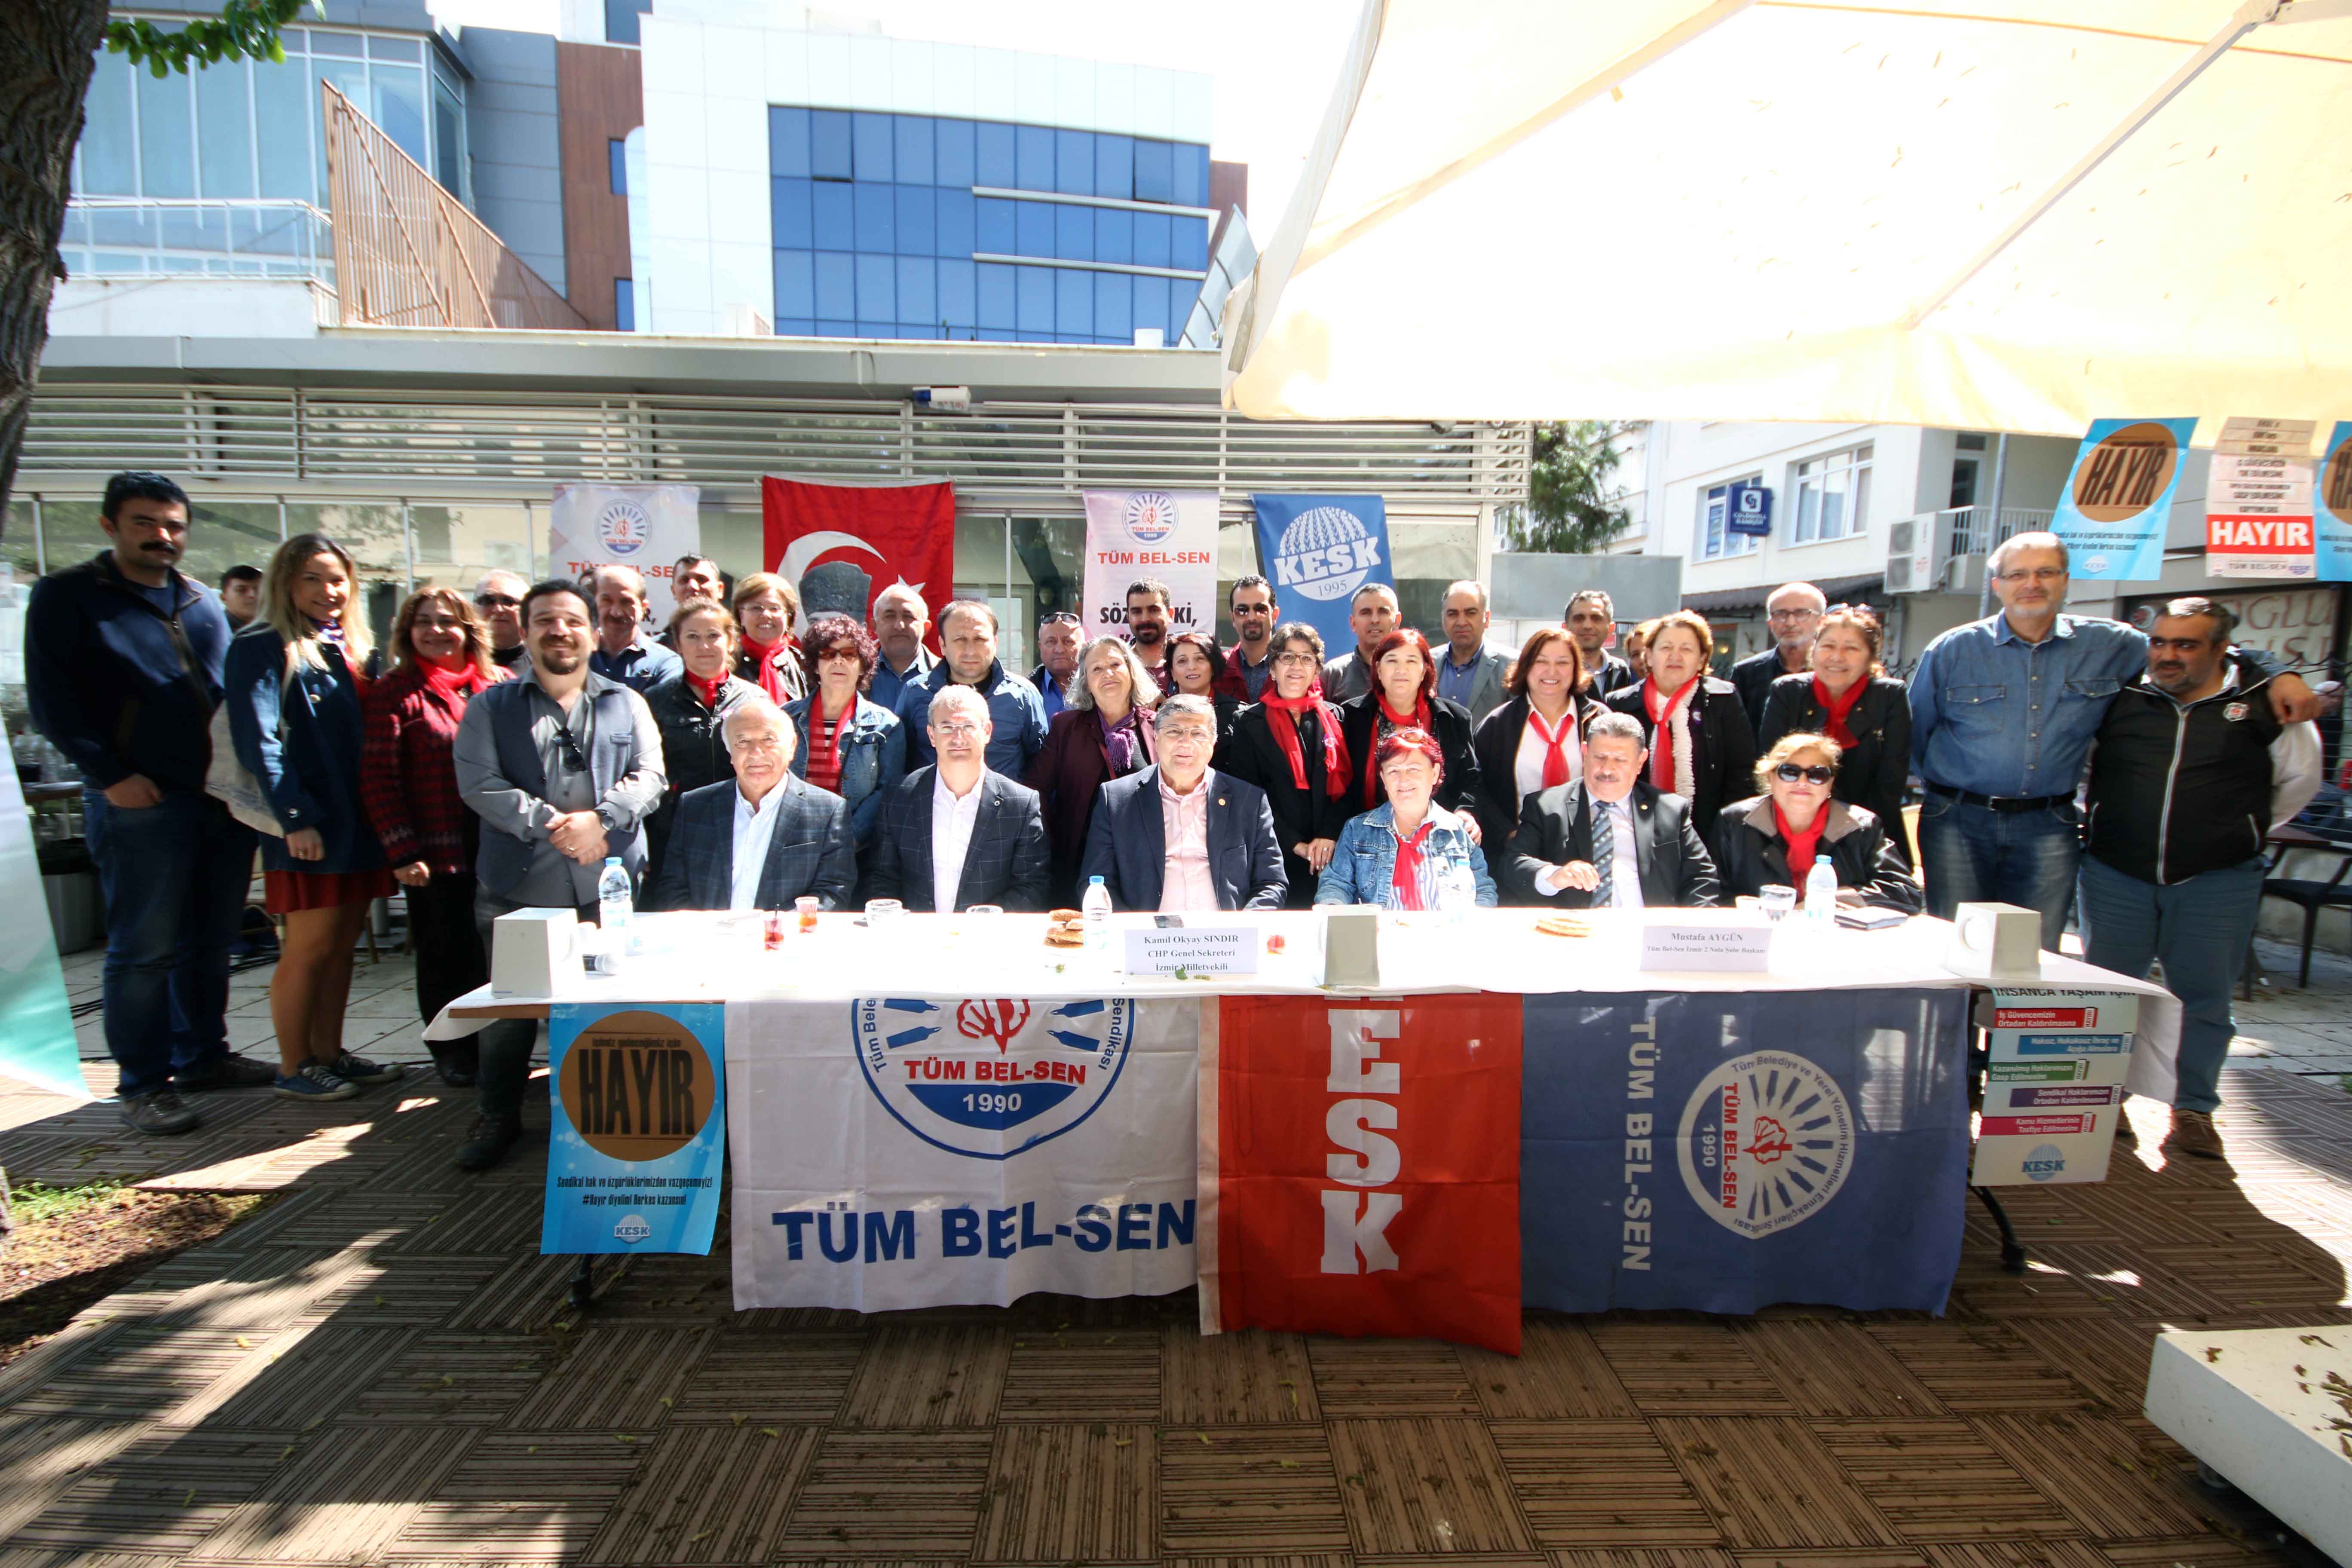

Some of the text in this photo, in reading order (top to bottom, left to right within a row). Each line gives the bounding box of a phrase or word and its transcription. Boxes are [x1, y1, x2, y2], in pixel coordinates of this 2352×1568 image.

[2077, 449, 2167, 505] HAYIR
[2211, 521, 2310, 546] HAYIR
[1097, 551, 1210, 564] TÜM BEL-SEN
[1274, 536, 1381, 585] KESK
[1318, 580, 1347, 597] 1995
[1144, 935, 1239, 945] Kamil Okyay SINDIR
[1672, 932, 1743, 941] Mustafa AYGÜN
[1156, 963, 1228, 971] İzmir Milletvekili
[1999, 1011, 2006, 1020] İş
[862, 998, 887, 1073] Tüm Bele
[1098, 998, 1125, 1070] Sendikası
[904, 1057, 1086, 1084] TÜM BEL-SEN
[1757, 1056, 1798, 1069] Belediye
[1800, 1066, 1812, 1076] ve
[579, 1049, 695, 1134] HAYIR
[1813, 1073, 1835, 1097] Yerel
[963, 1093, 1022, 1114] 1990
[1831, 1097, 1849, 1138] Yönetim
[1623, 1017, 1661, 1271] TÜM BEL-SEN
[1703, 1124, 1716, 1167] 1990
[1722, 1082, 1740, 1209] TÜM BEL-SEN
[1822, 1143, 1849, 1194] Hizmetleri
[2022, 1160, 2065, 1173] KESK
[557, 1176, 712, 1189] Sendikal hak ve özgürlüklerimizden vazgeçemeyiz!
[582, 1194, 686, 1207] #Hayır diyelim! Herkes kazansın!
[615, 1226, 649, 1236] KESK
[772, 1199, 1196, 1263] TÜM BEL-SEN
